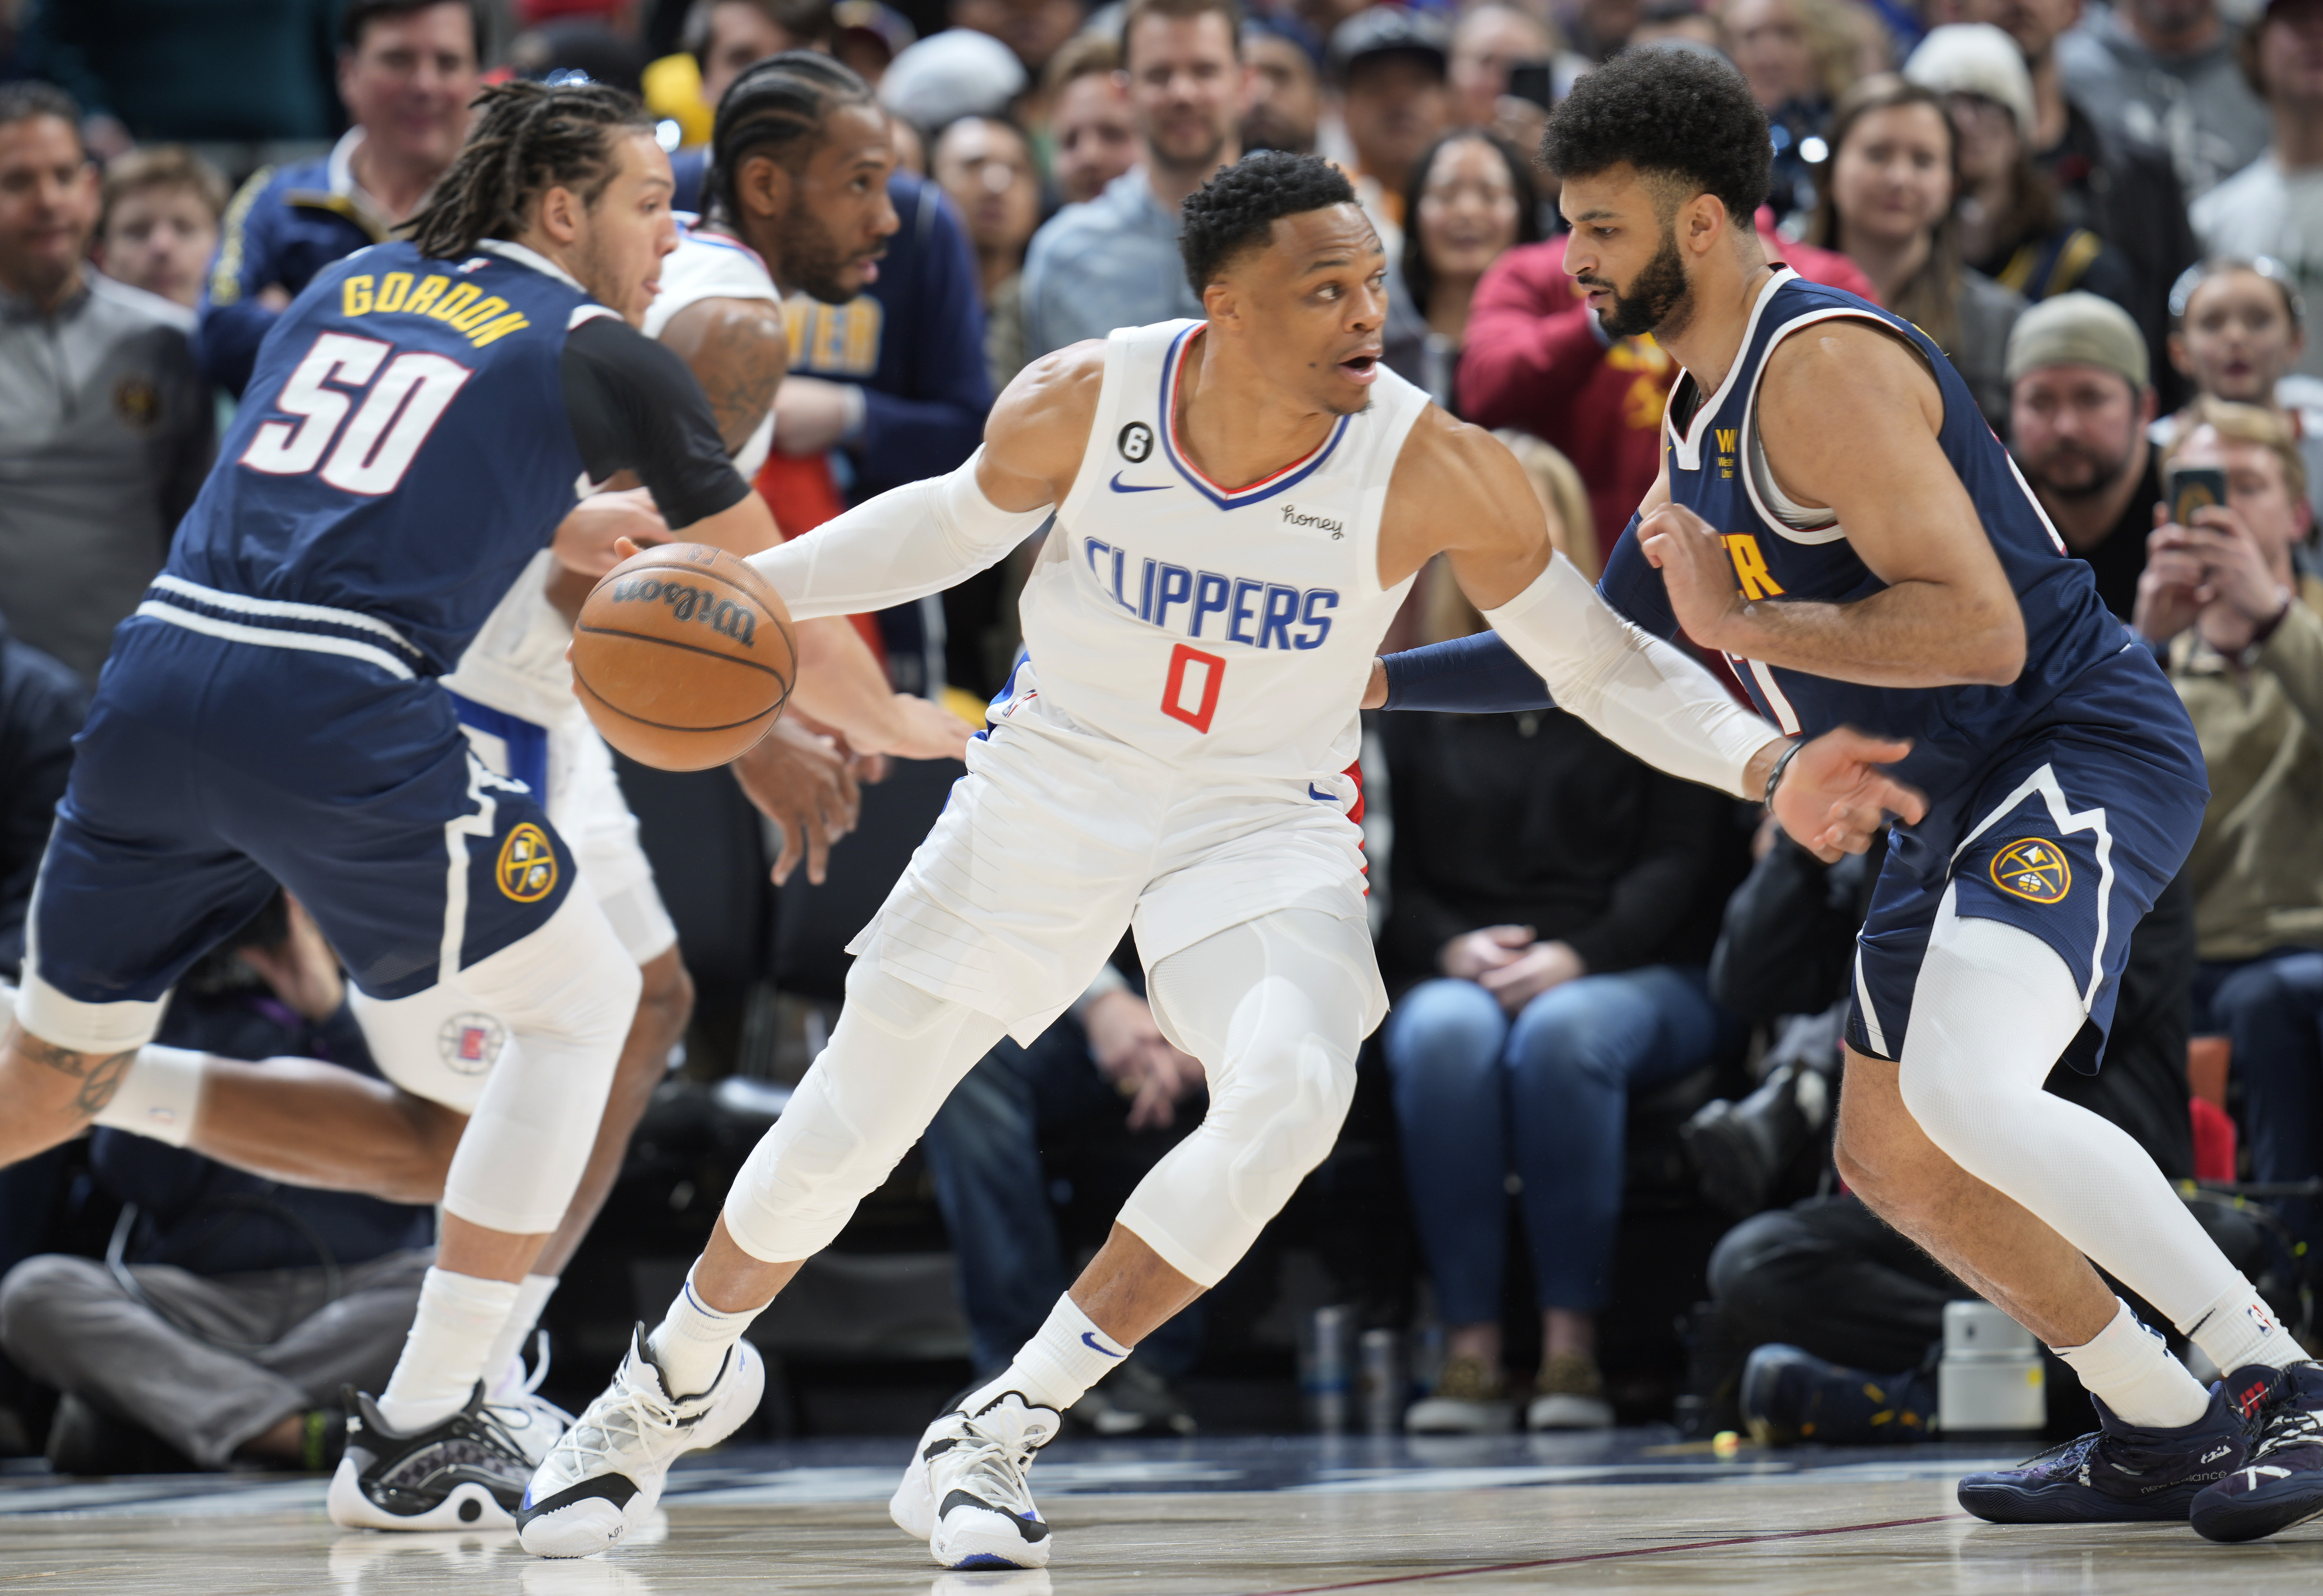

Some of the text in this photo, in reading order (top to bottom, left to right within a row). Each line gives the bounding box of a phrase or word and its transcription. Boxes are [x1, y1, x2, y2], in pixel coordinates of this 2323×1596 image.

[343, 271, 531, 348] GORDON
[236, 330, 475, 495] 50
[1123, 426, 1149, 460] 6
[1281, 505, 1344, 540] honey
[612, 579, 757, 649] Wilson
[1084, 536, 1340, 650] CLIPPERS
[1160, 643, 1226, 735] 0
